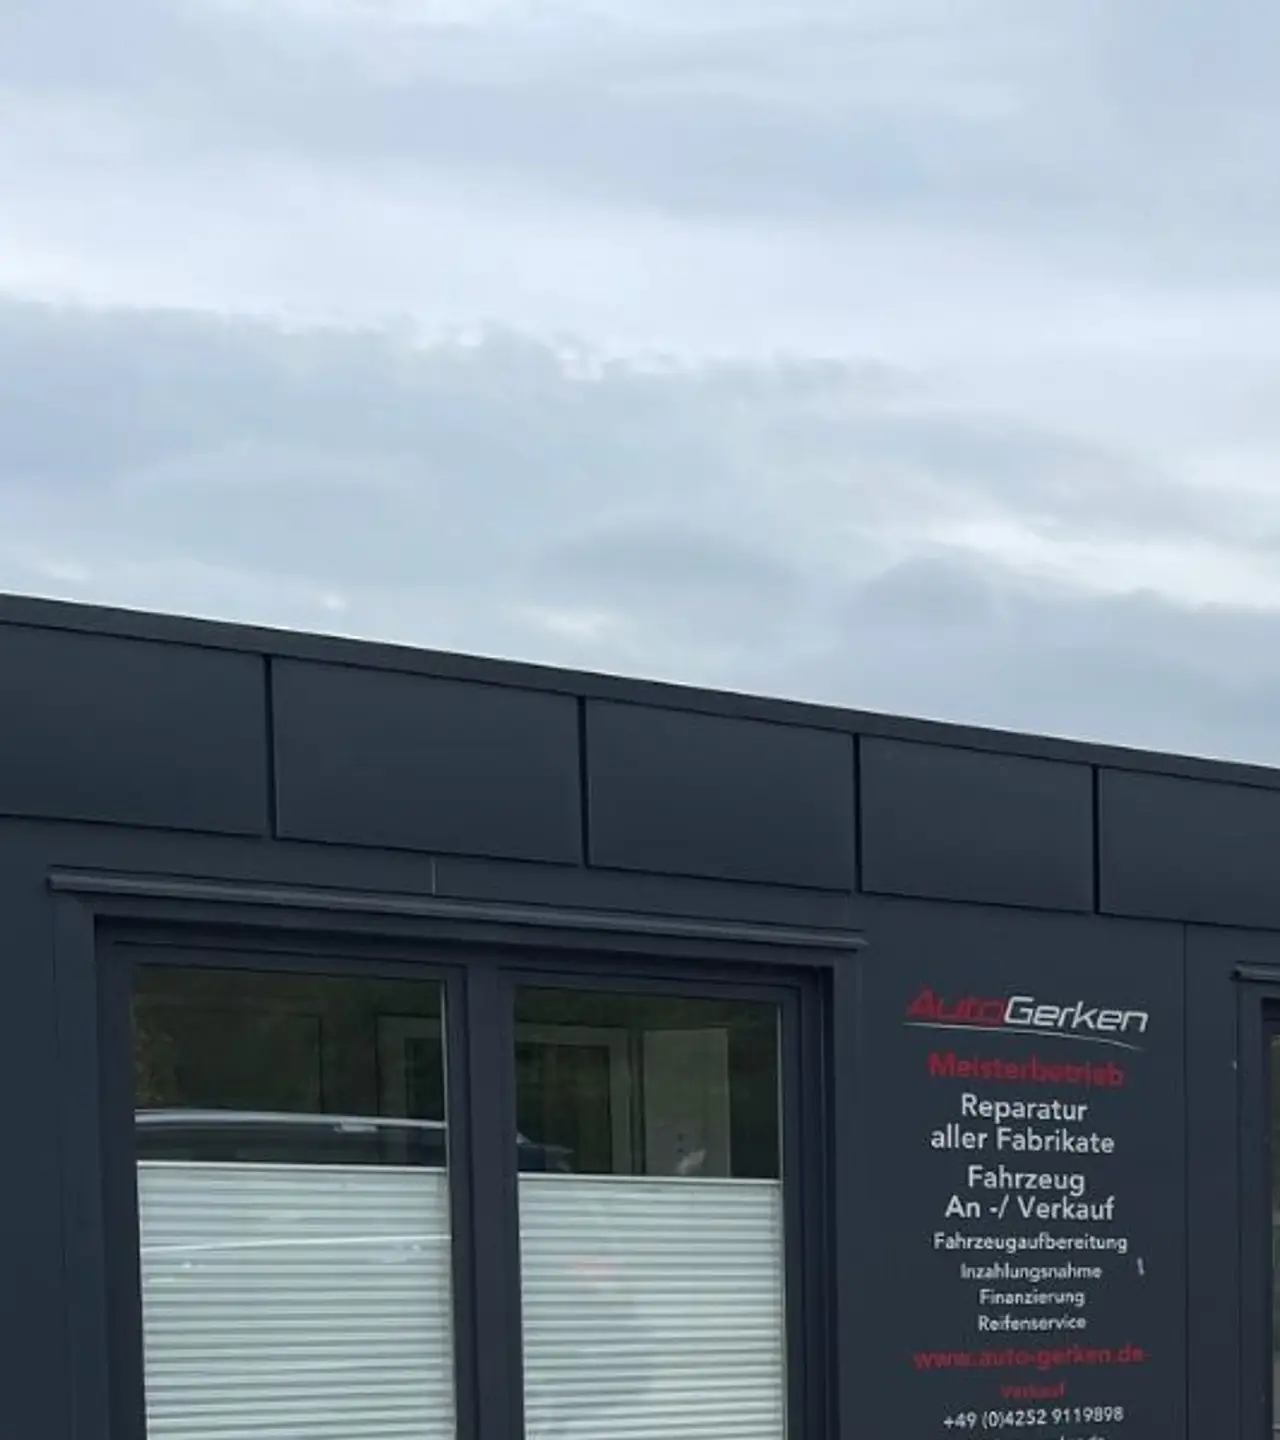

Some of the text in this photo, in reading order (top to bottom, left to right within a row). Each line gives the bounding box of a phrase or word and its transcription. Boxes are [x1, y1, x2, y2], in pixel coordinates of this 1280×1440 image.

[927, 1053, 1125, 1086] Meisterbetrieb
[961, 1093, 1088, 1123] Reparatur
[930, 1123, 1115, 1153] aller Fabrikate
[967, 1165, 1086, 1196] Fahrzeug
[944, 1195, 981, 1218] An
[1017, 1196, 1116, 1220] Verkauf
[933, 1232, 1128, 1254] Fahrzeugaufbereitung
[960, 1262, 1102, 1283] Inzahlungsnahme
[978, 1288, 1086, 1307] Finanzierung
[978, 1315, 1087, 1331] Reifenservice
[914, 1344, 1144, 1370] www.auto-gerken.de
[944, 1406, 1124, 1430] +49 (0)4252 9119898
